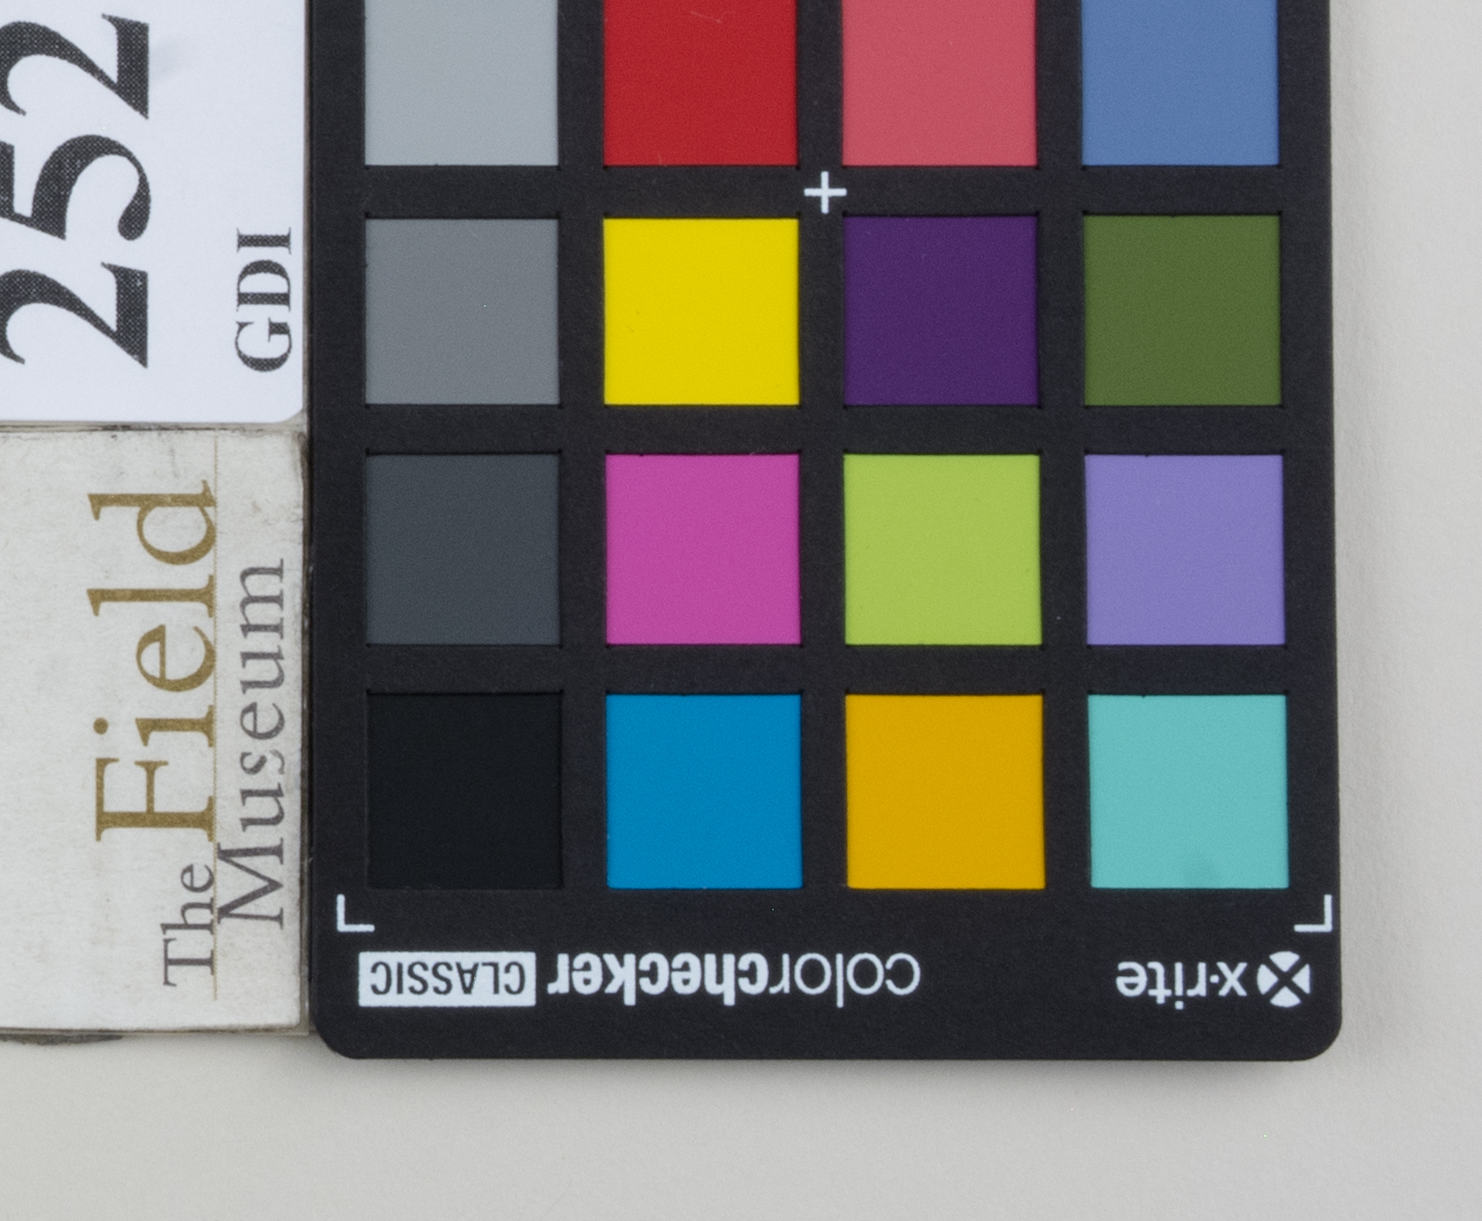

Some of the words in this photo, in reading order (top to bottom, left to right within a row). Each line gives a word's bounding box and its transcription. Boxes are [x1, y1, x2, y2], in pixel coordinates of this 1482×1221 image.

[233, 230, 294, 374] GDI
[86, 480, 218, 843] Field
[217, 558, 286, 931] Museum
[160, 862, 215, 988] The
[370, 961, 526, 996] CLASSIC
[547, 952, 921, 1008] colorchecker
